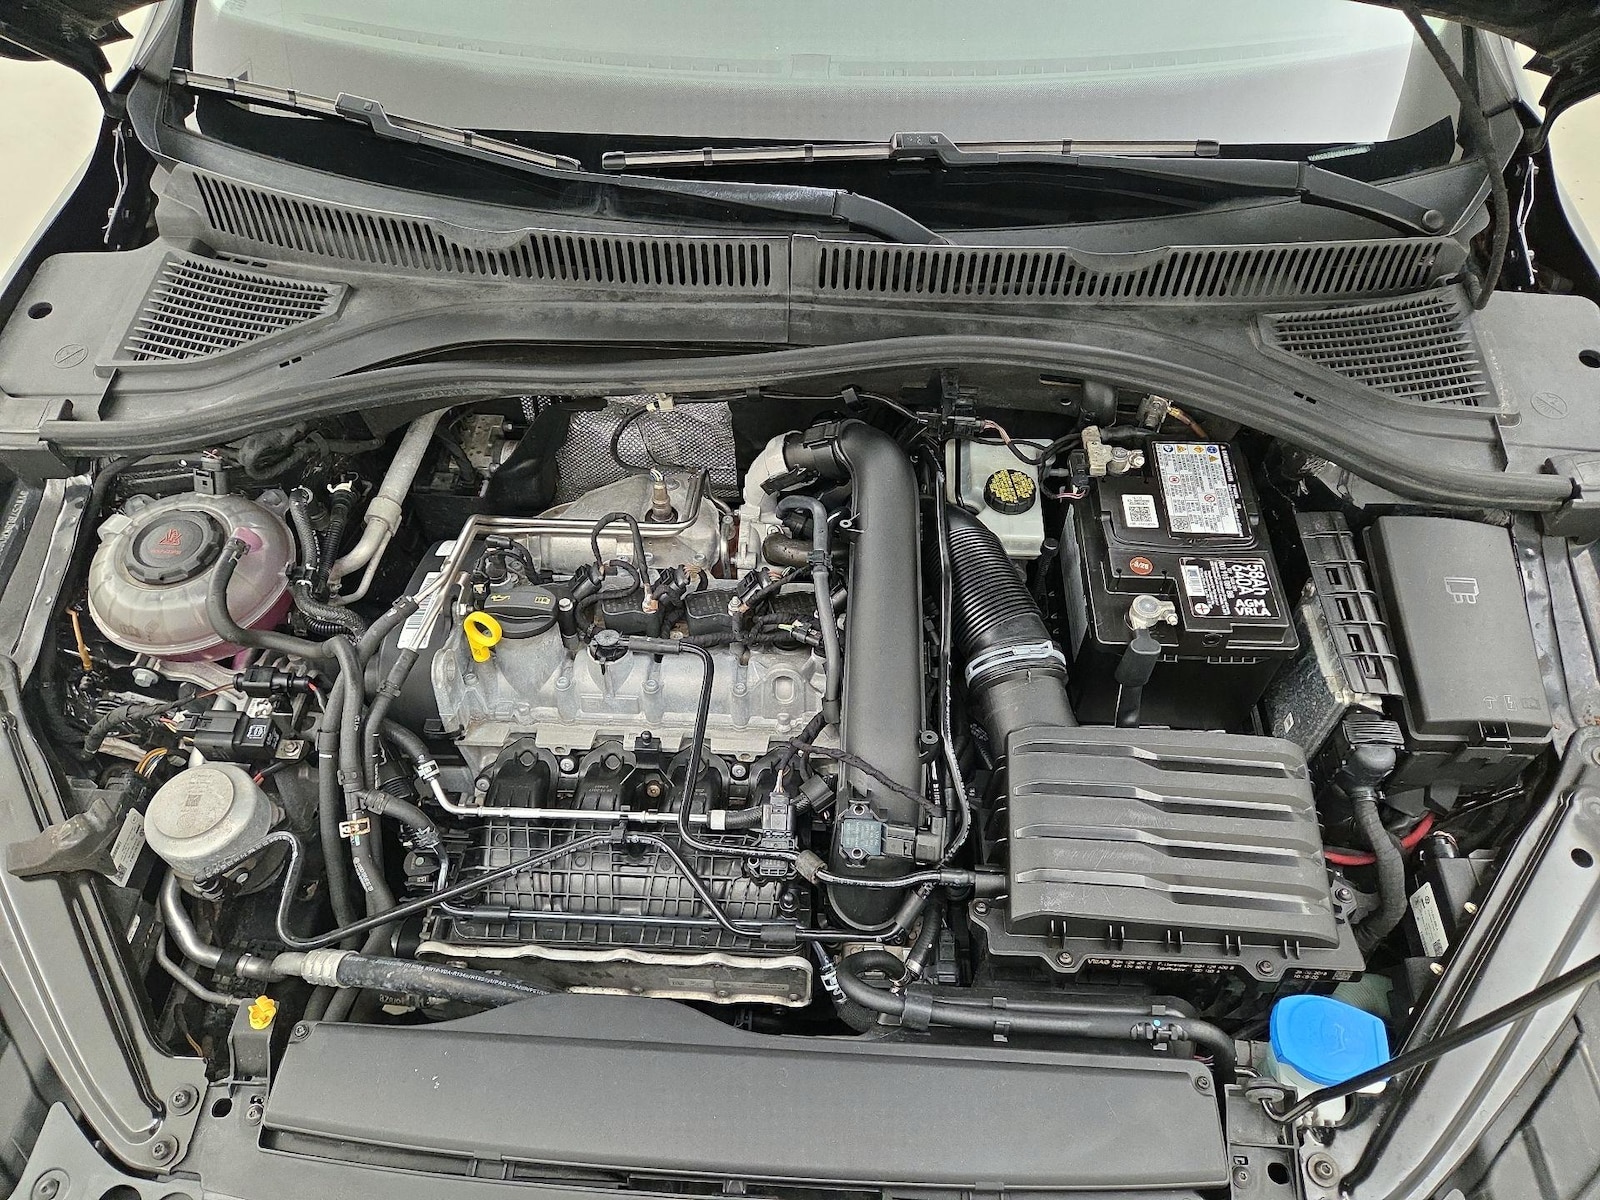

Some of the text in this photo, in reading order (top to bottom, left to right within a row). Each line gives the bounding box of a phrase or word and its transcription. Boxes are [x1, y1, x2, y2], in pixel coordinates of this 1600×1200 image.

[1231, 564, 1254, 596] 640A
[1246, 564, 1270, 596] 58Ah
[1234, 607, 1271, 616] VRLA
[1235, 599, 1266, 608] AGM
